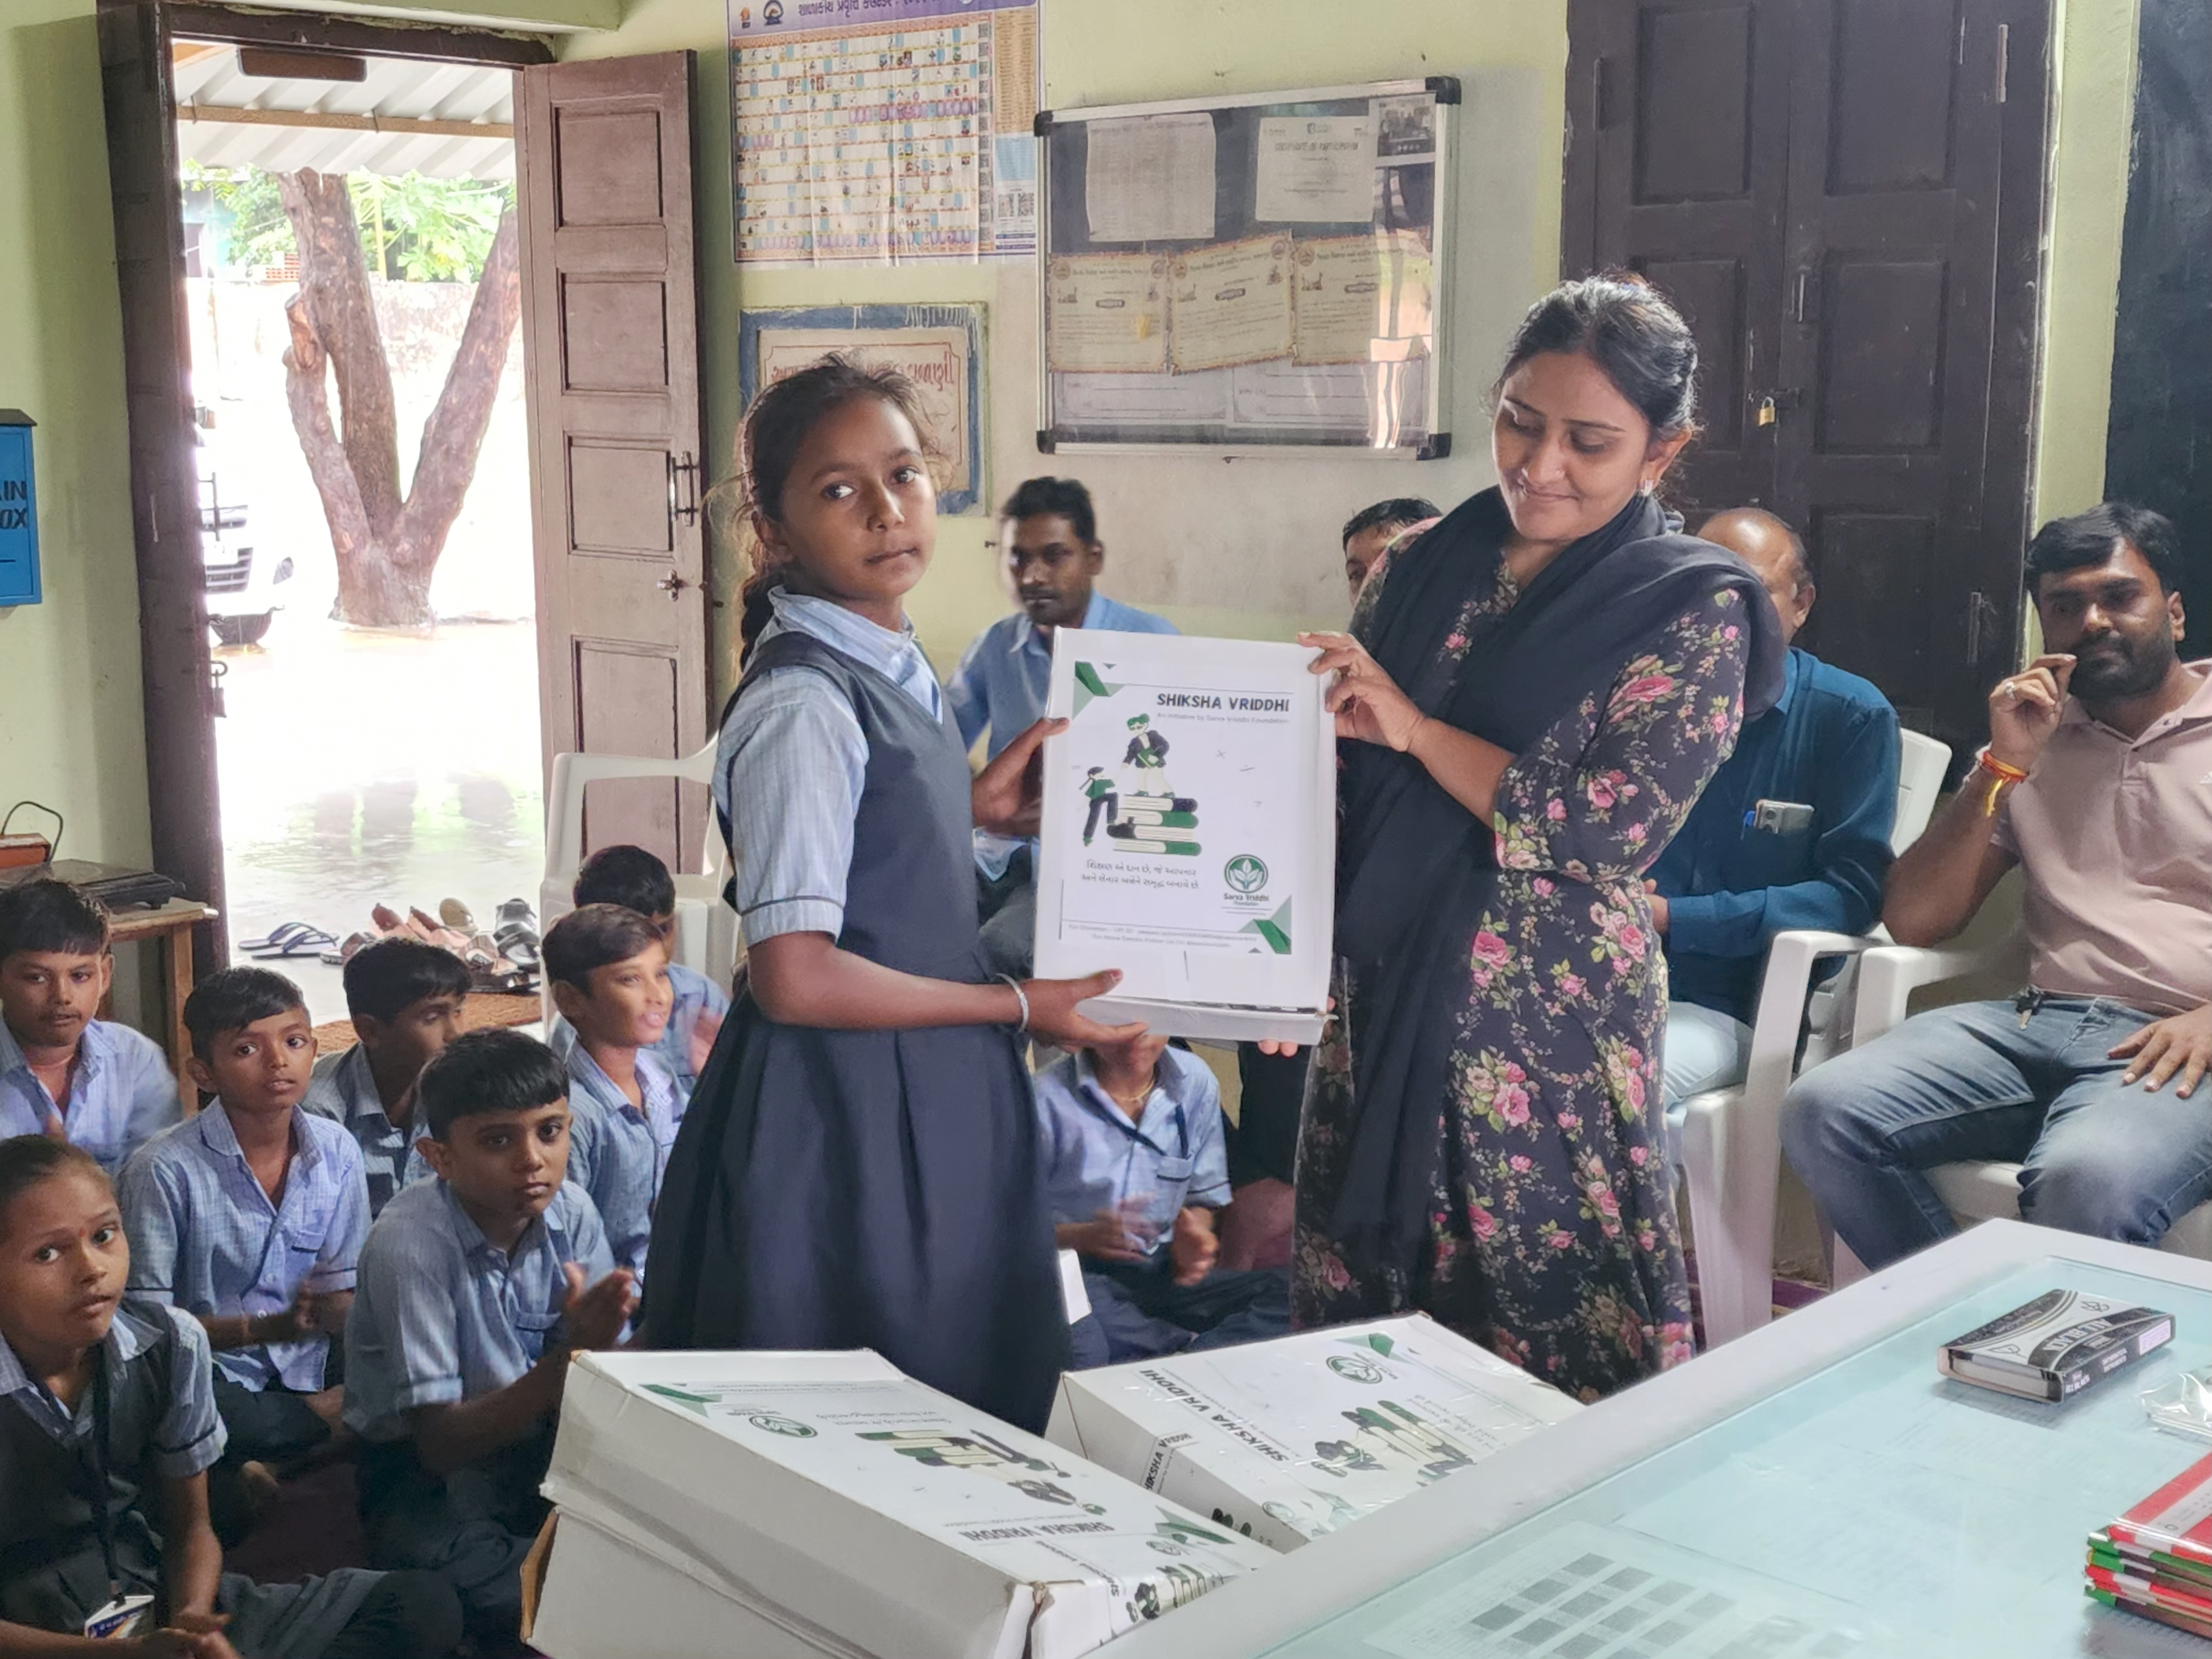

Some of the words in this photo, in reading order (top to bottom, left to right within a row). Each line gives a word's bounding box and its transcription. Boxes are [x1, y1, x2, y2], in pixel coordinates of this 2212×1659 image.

[0, 480, 27, 501] IN
[1156, 692, 1222, 709] SHIKSHA
[1228, 696, 1290, 712] VRIDDHI
[1139, 1369, 1211, 1412] VRIDDHI
[1211, 1414, 1290, 1462] SHIKSHA
[1144, 1451, 1165, 1491] HIKSHA
[958, 1526, 1042, 1541] VRIDDHI
[1034, 1522, 1115, 1535] SHIKSHA
